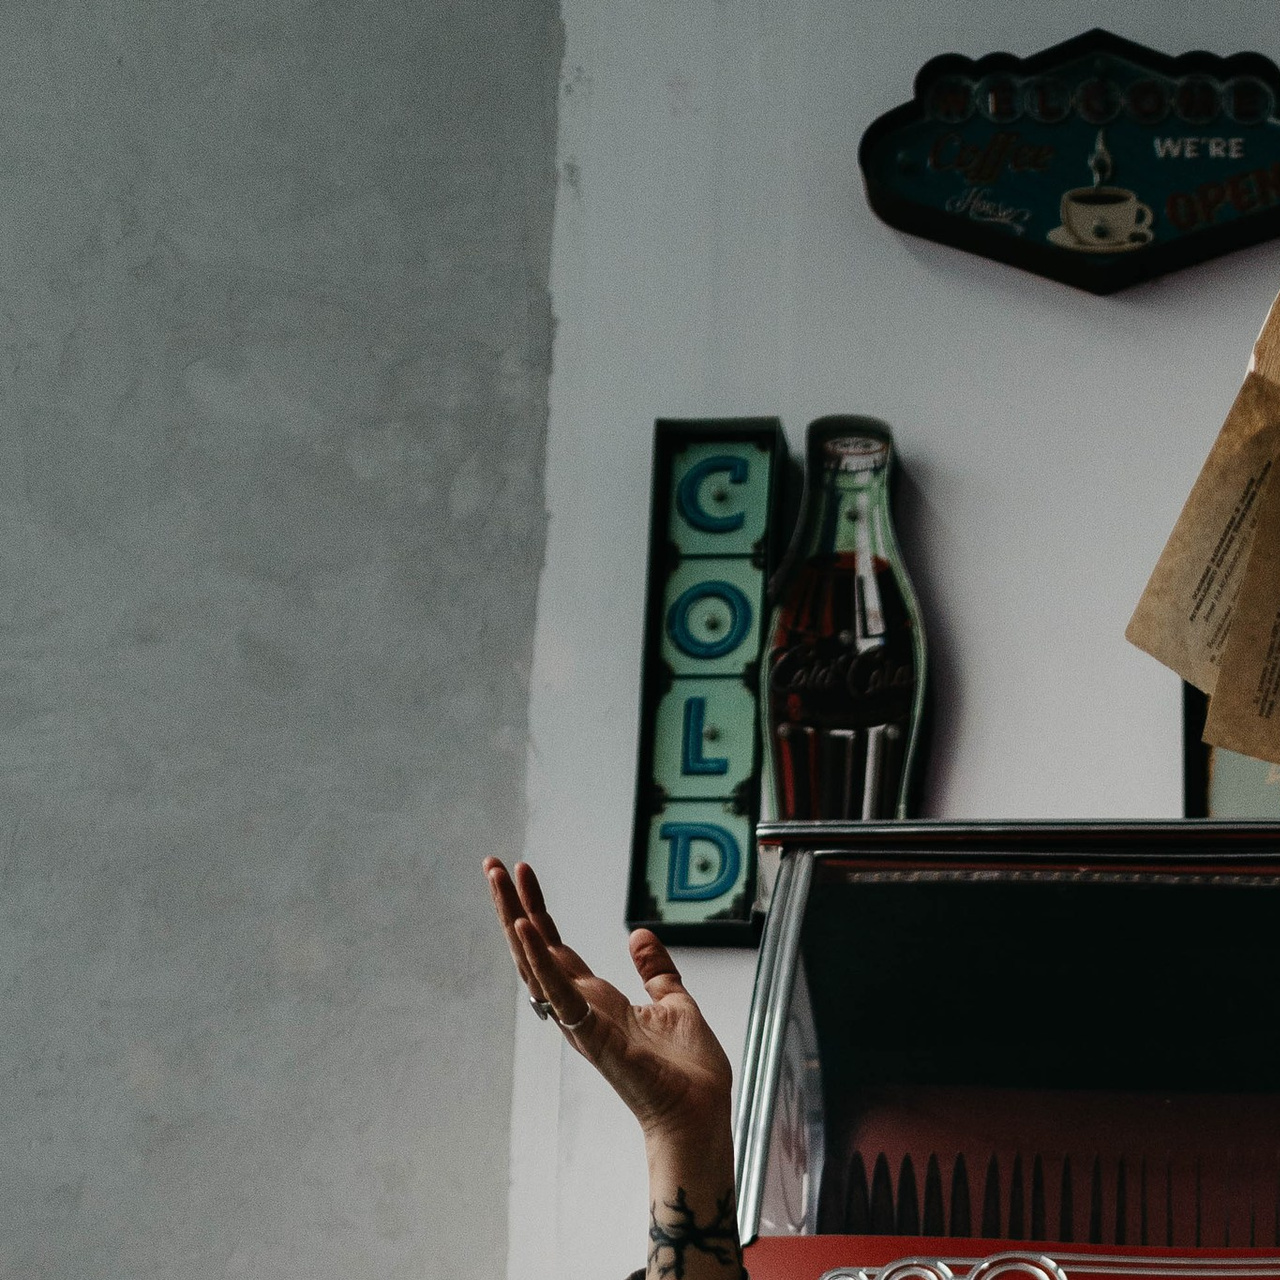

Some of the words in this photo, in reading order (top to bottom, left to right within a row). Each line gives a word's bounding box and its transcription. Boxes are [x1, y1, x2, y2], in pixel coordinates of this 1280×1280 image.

[926, 132, 1057, 185] Coffee
[1153, 136, 1246, 160] WE'RE
[660, 455, 753, 902] COLD
